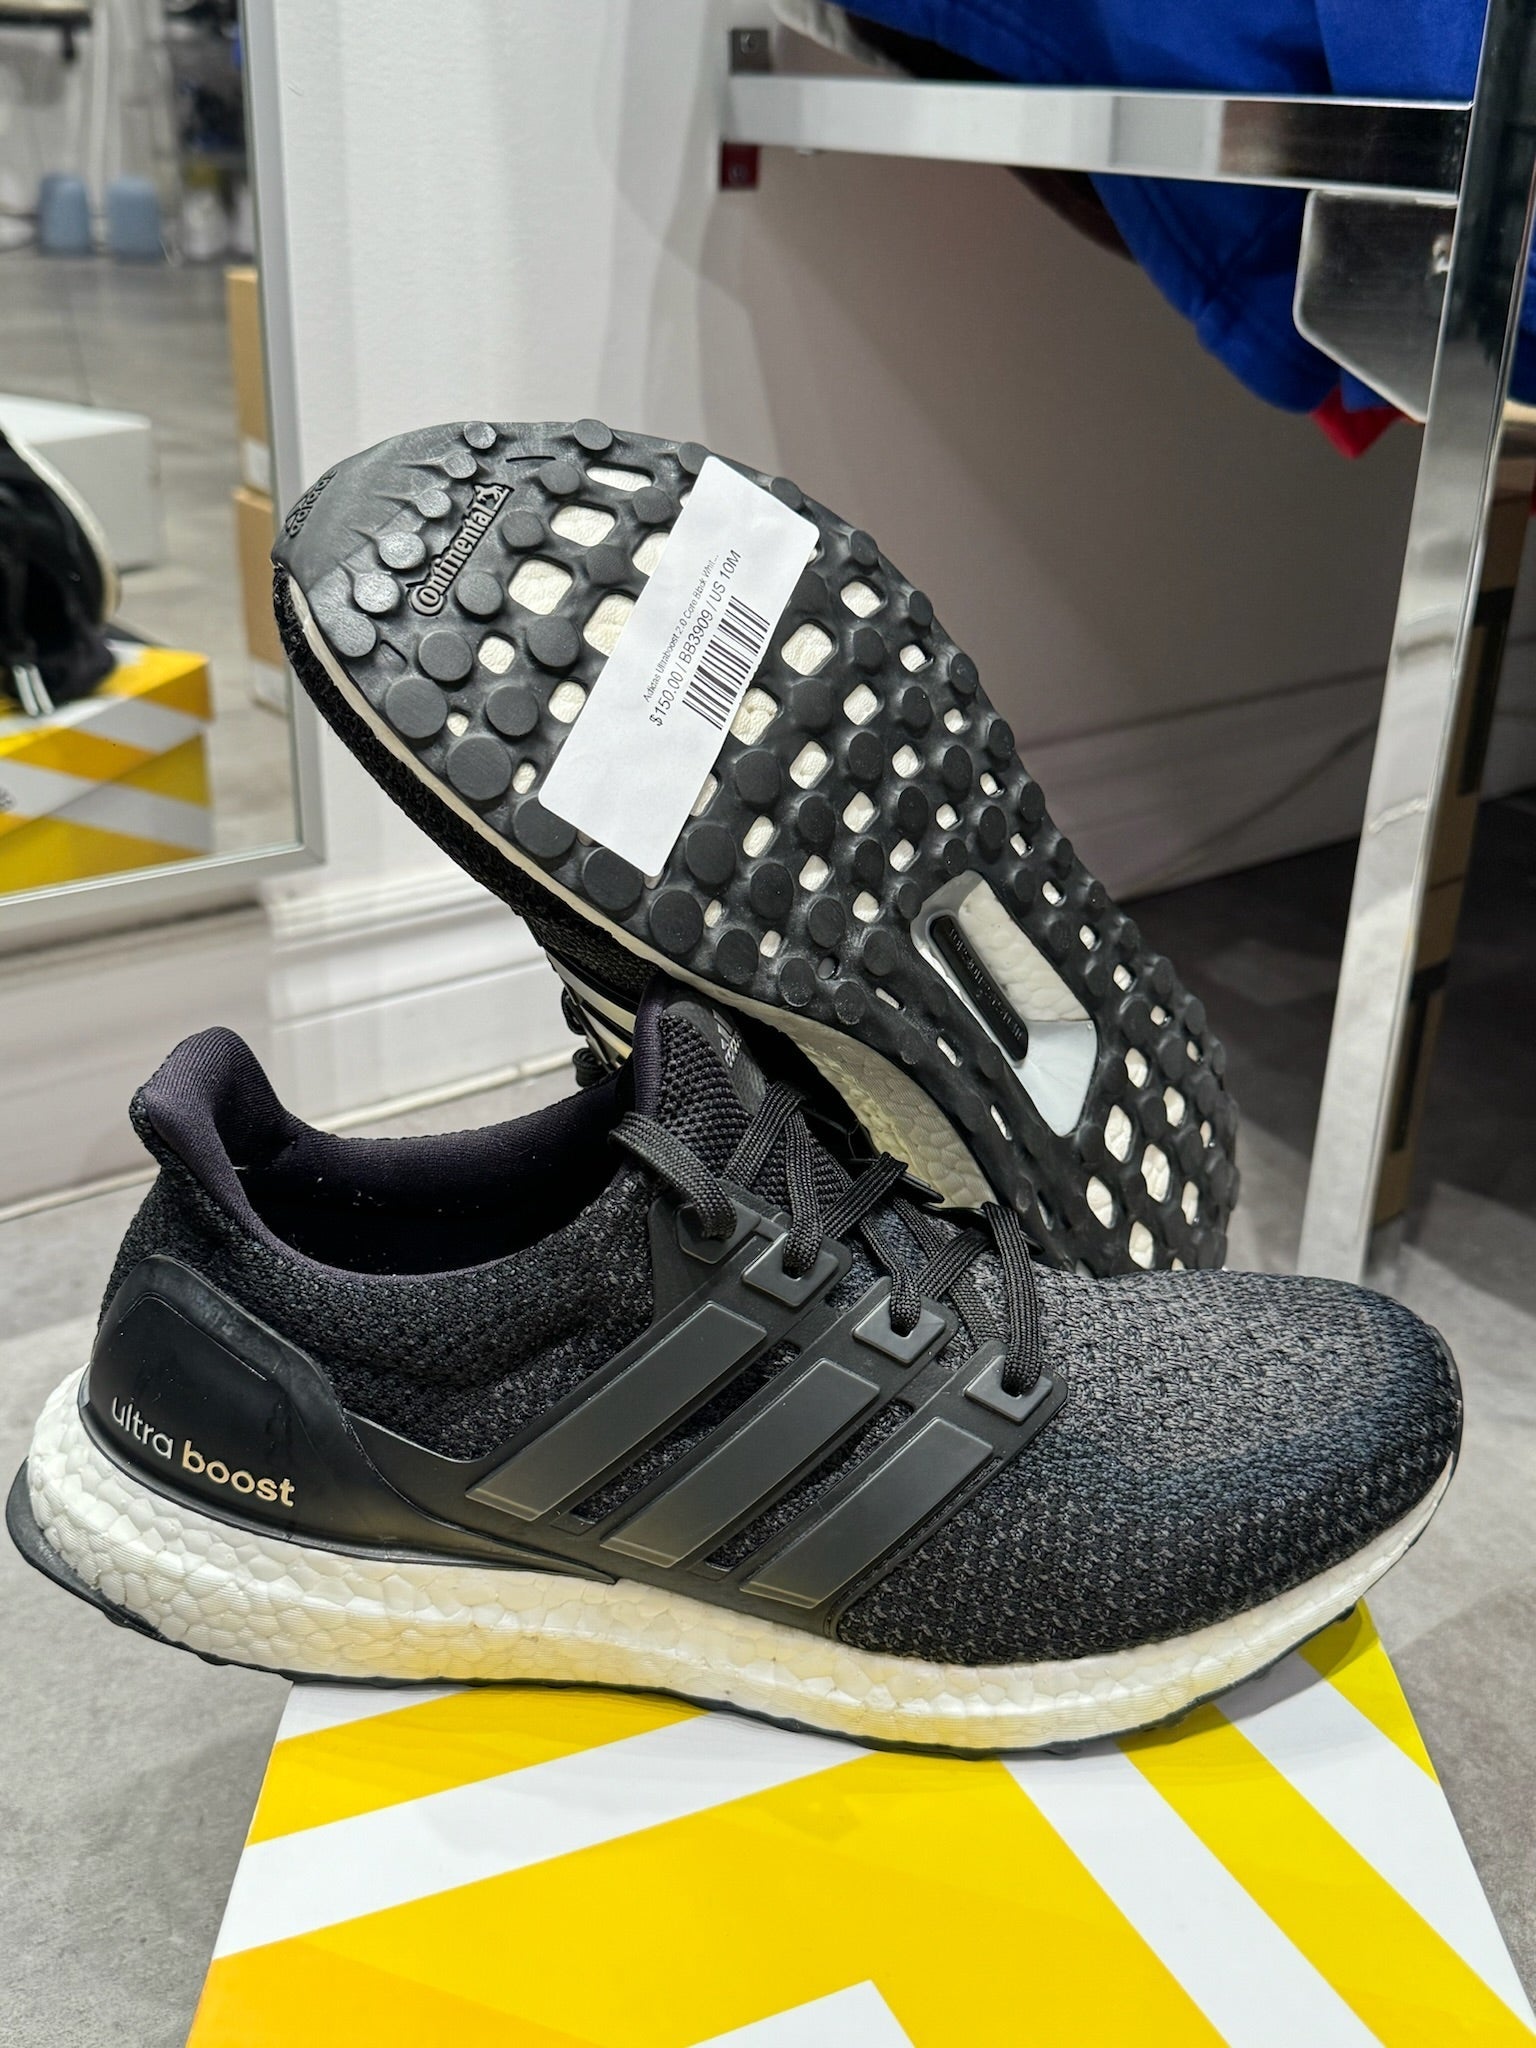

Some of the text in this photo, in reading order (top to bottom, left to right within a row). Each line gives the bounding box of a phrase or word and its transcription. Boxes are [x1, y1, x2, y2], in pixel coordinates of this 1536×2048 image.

[409, 501, 497, 616] Continental
[643, 673, 661, 702] Adidas
[656, 632, 680, 673] Ultraboost
[675, 618, 687, 635] 2.0
[649, 671, 684, 726] $150.00
[679, 609, 713, 664] BB3909
[709, 581, 726, 602] US
[720, 549, 742, 579] 10M
[112, 1397, 295, 1507] ultra boost
